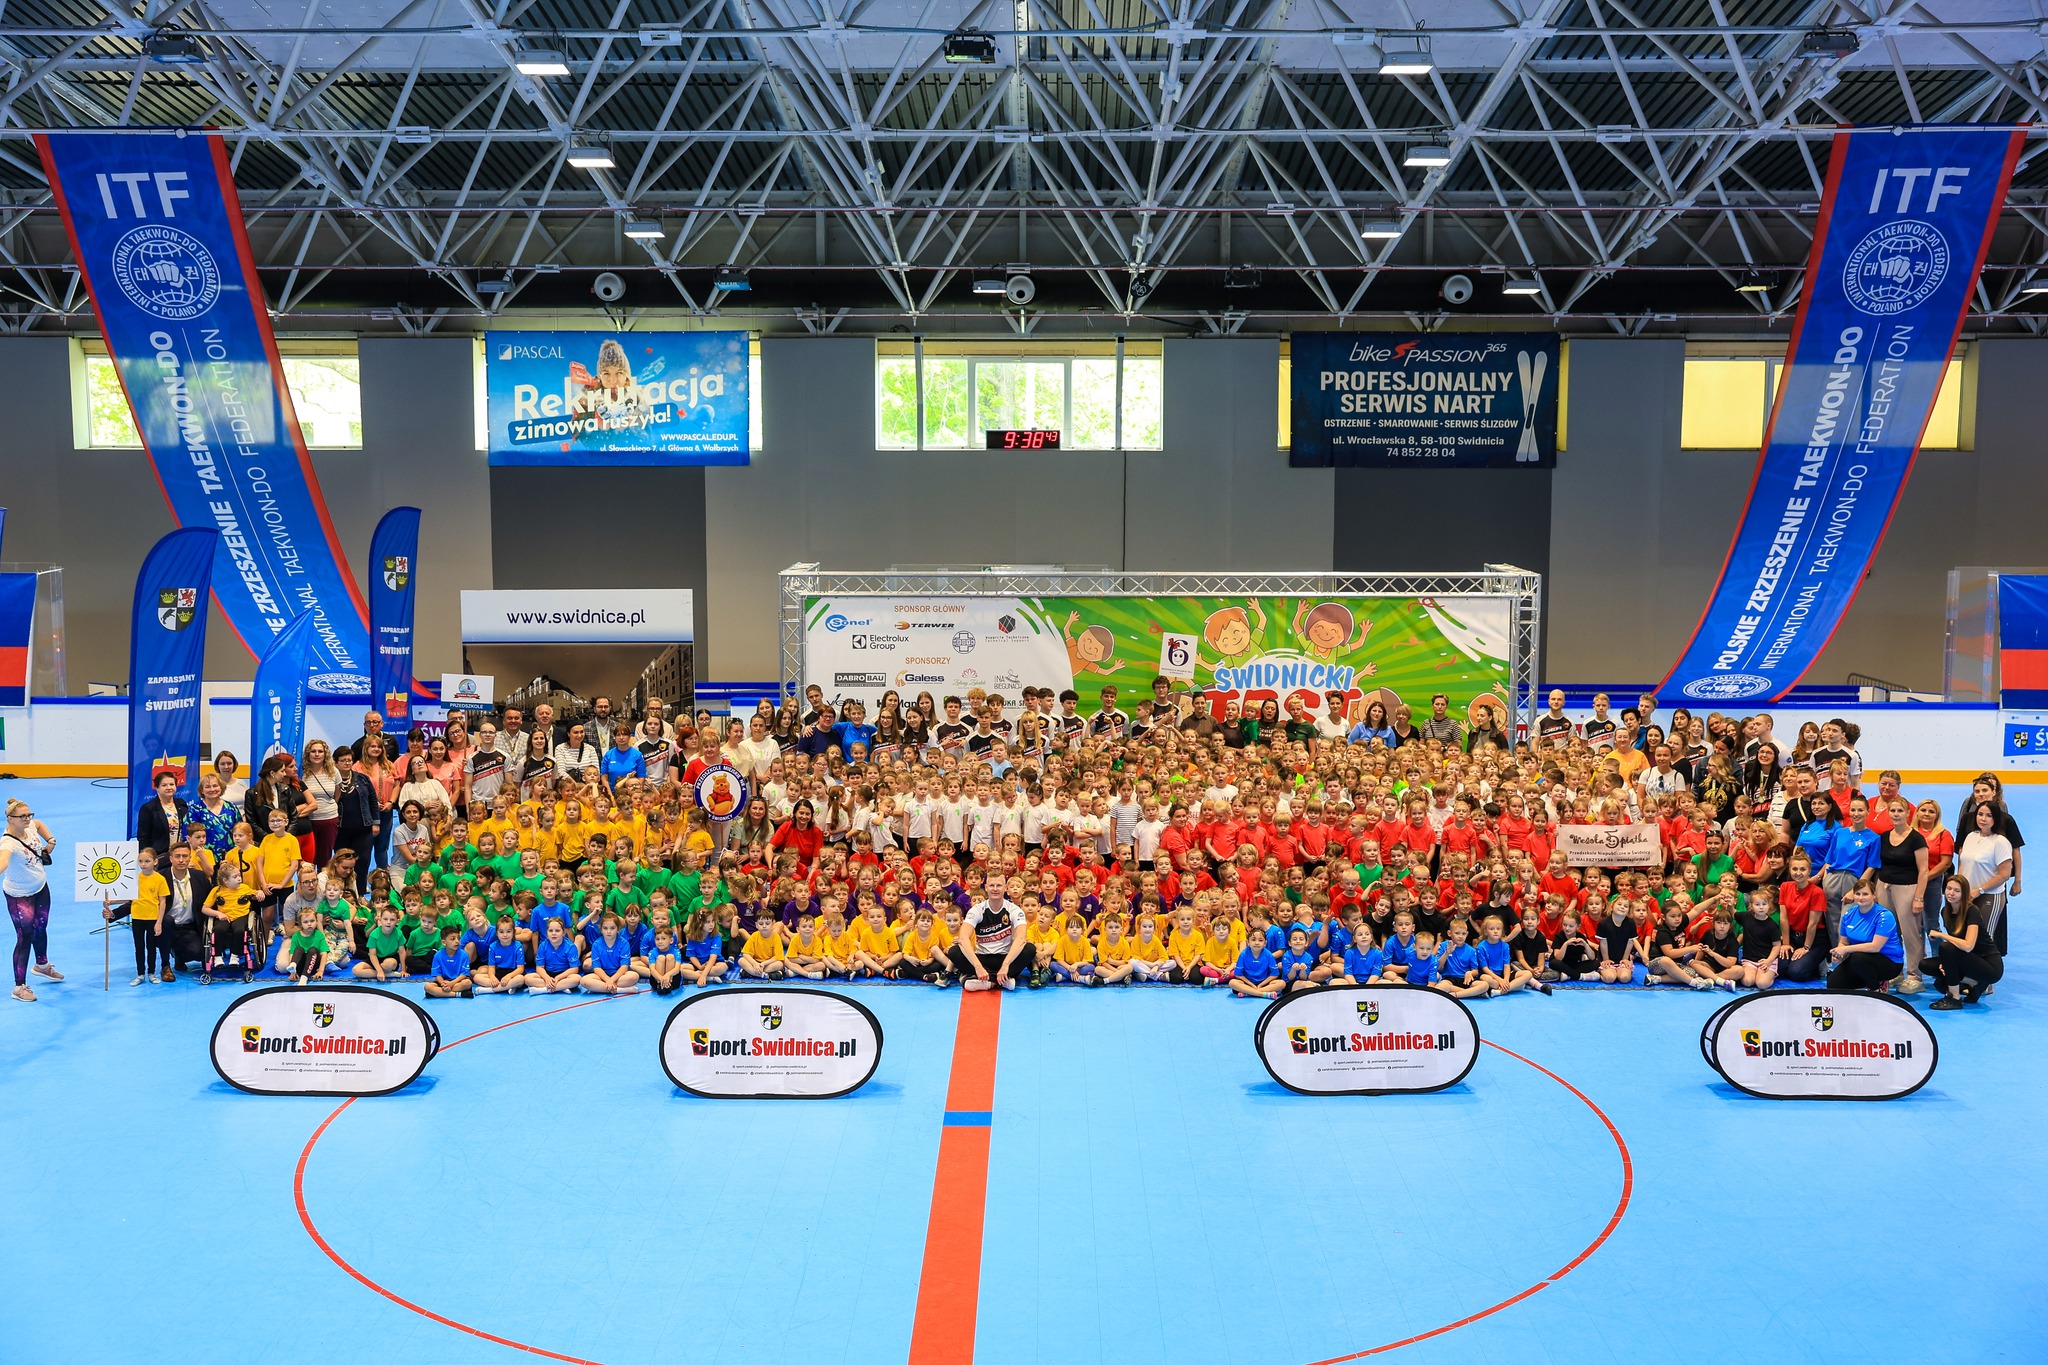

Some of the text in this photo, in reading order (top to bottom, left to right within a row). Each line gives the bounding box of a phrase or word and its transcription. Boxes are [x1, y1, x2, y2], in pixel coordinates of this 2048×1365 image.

[95, 171, 190, 219] ITF
[1868, 167, 1971, 214] ITF
[117, 228, 217, 308] INTERNATIONAL TAEKWON-DO FEDERATION
[1846, 223, 1946, 304] INTERNATIONAL TAEKWON-DO FEDERATION
[161, 306, 197, 317] POLAND
[1867, 301, 1904, 312] POLAND
[513, 346, 565, 359] PASCAL
[1349, 341, 1391, 363] bike
[1487, 343, 1507, 352] 365
[200, 328, 260, 456] FEDERATION
[1320, 371, 1514, 392] PROFESJONALNY
[514, 367, 725, 420] Rekrutacja
[1340, 393, 1495, 414] SERWIS NART
[514, 404, 672, 441] zimowa ruszyła!
[1324, 417, 1519, 429] OSTRZENIE SMAROWANIE SERWIS ŚLIZGÓW
[1003, 431, 1058, 449] 9:38 43
[1332, 436, 1345, 445] ul.
[1347, 436, 1406, 445] Wrocławska
[1408, 436, 1419, 446] 8,
[1420, 436, 1456, 445] 58-100
[1386, 448, 1456, 457] 74 852 28 04
[149, 330, 281, 615] ZRZESZENIE TAEKWON-DO
[1712, 614, 1762, 670] POLSKIE
[1745, 497, 1811, 612] ZRZESZENIE
[1793, 325, 1864, 491] TAEKWON-DO
[1758, 324, 1914, 669] INTERNATIONAL TAEKWON-DO FEDERATION
[247, 466, 305, 577] TAEKWON-DO
[506, 609, 646, 627] www.swidnica.pl
[894, 604, 966, 613] SPONSOR GŁÓWNY
[869, 634, 910, 642] Electrolux
[869, 642, 896, 651] Group
[905, 657, 951, 665] SPONSORZY
[905, 674, 945, 682] Galess
[1215, 661, 1354, 691] ŚWIDNICKI
[168, 687, 179, 695] DO
[244, 1027, 407, 1057] Sport.Swidnica.pl
[692, 1030, 856, 1059] Sport.Swidnica.pl
[1291, 1028, 1456, 1055] Sport.Swidnica.pl
[1744, 1031, 1913, 1060] Sport.Swidnica.pl
